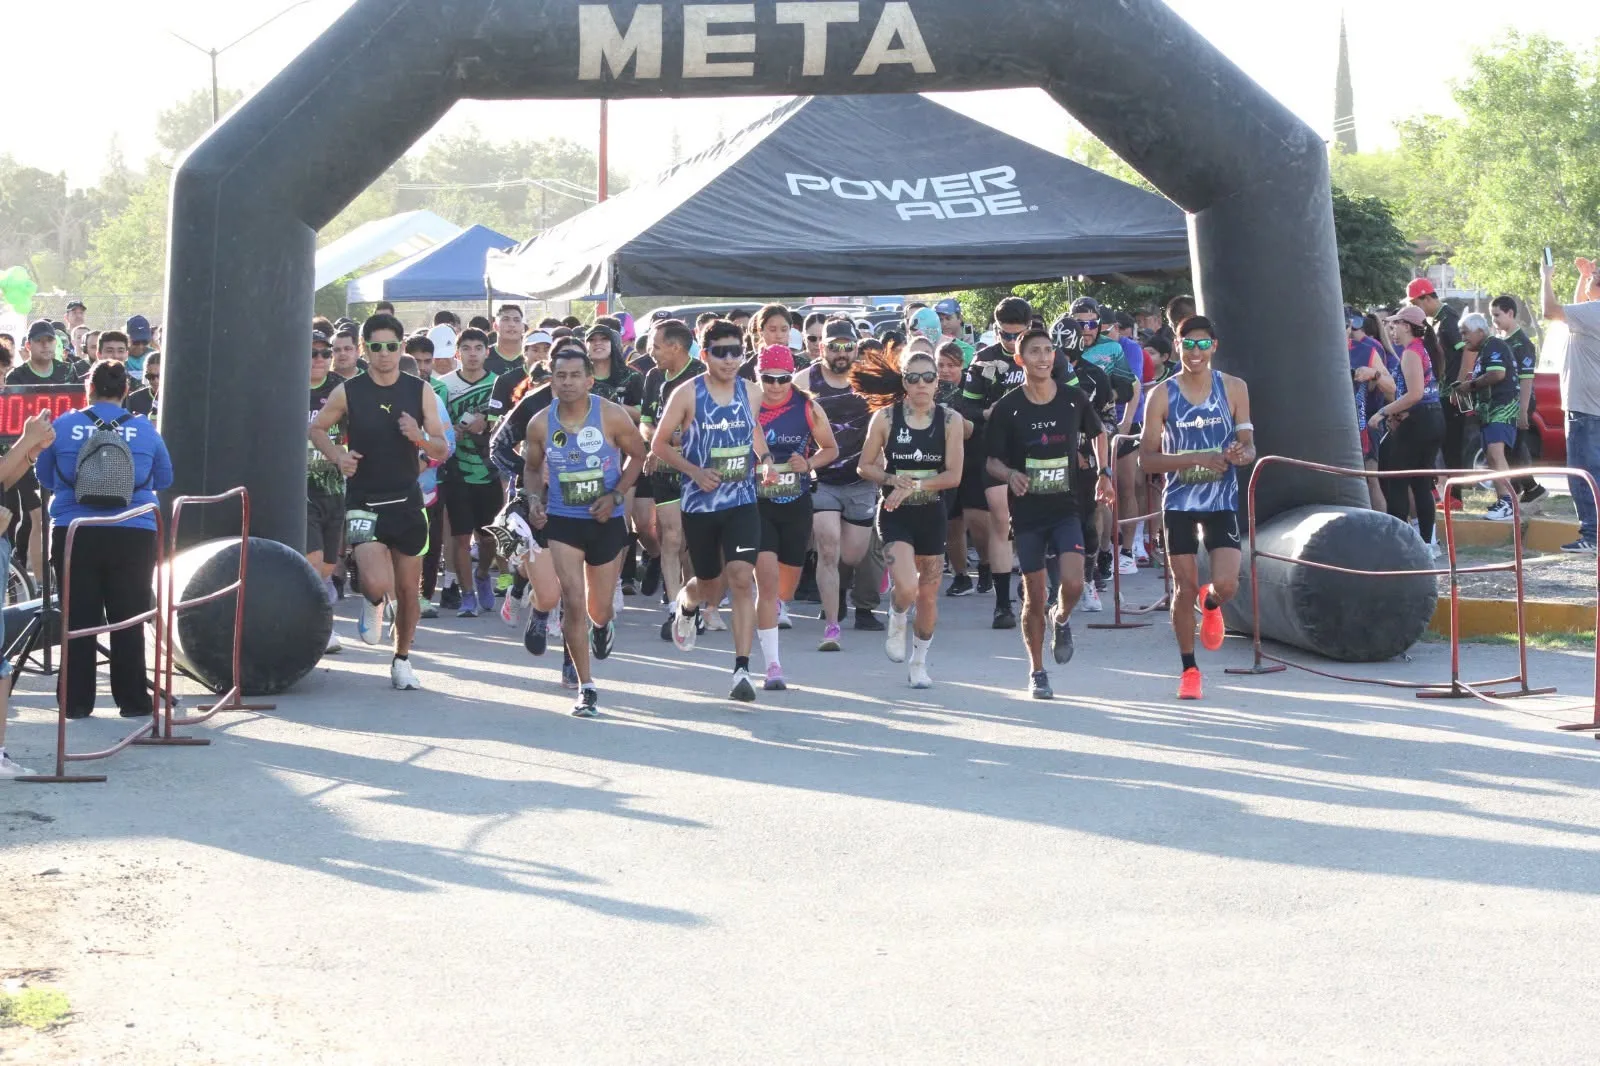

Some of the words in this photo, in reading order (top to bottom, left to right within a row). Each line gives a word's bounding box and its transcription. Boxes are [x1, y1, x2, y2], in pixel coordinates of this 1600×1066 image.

[578, 1, 936, 80] META
[785, 165, 1018, 201] POWER
[896, 190, 1028, 221] ADE
[71, 425, 137, 441] STFF
[726, 457, 746, 470] 112
[777, 472, 796, 486] 30
[1038, 468, 1065, 482] 142
[575, 480, 599, 494] 141
